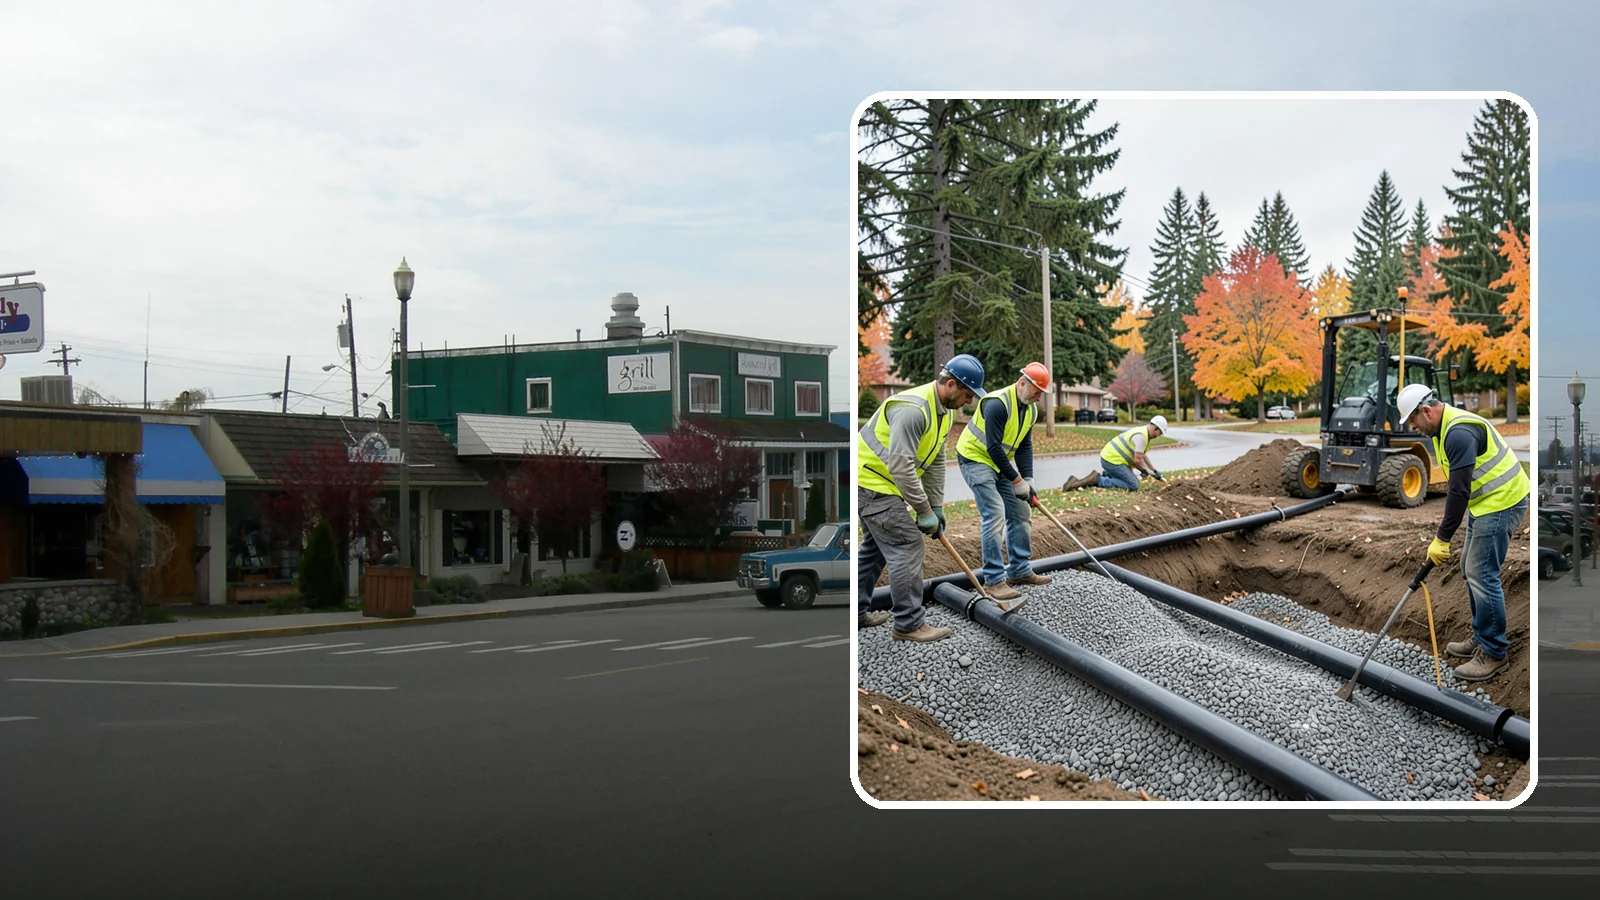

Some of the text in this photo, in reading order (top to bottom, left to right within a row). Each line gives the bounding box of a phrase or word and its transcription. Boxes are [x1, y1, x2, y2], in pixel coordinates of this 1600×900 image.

[0, 297, 19, 323] ly
[20, 337, 37, 345] Salads
[617, 356, 654, 391] grill
